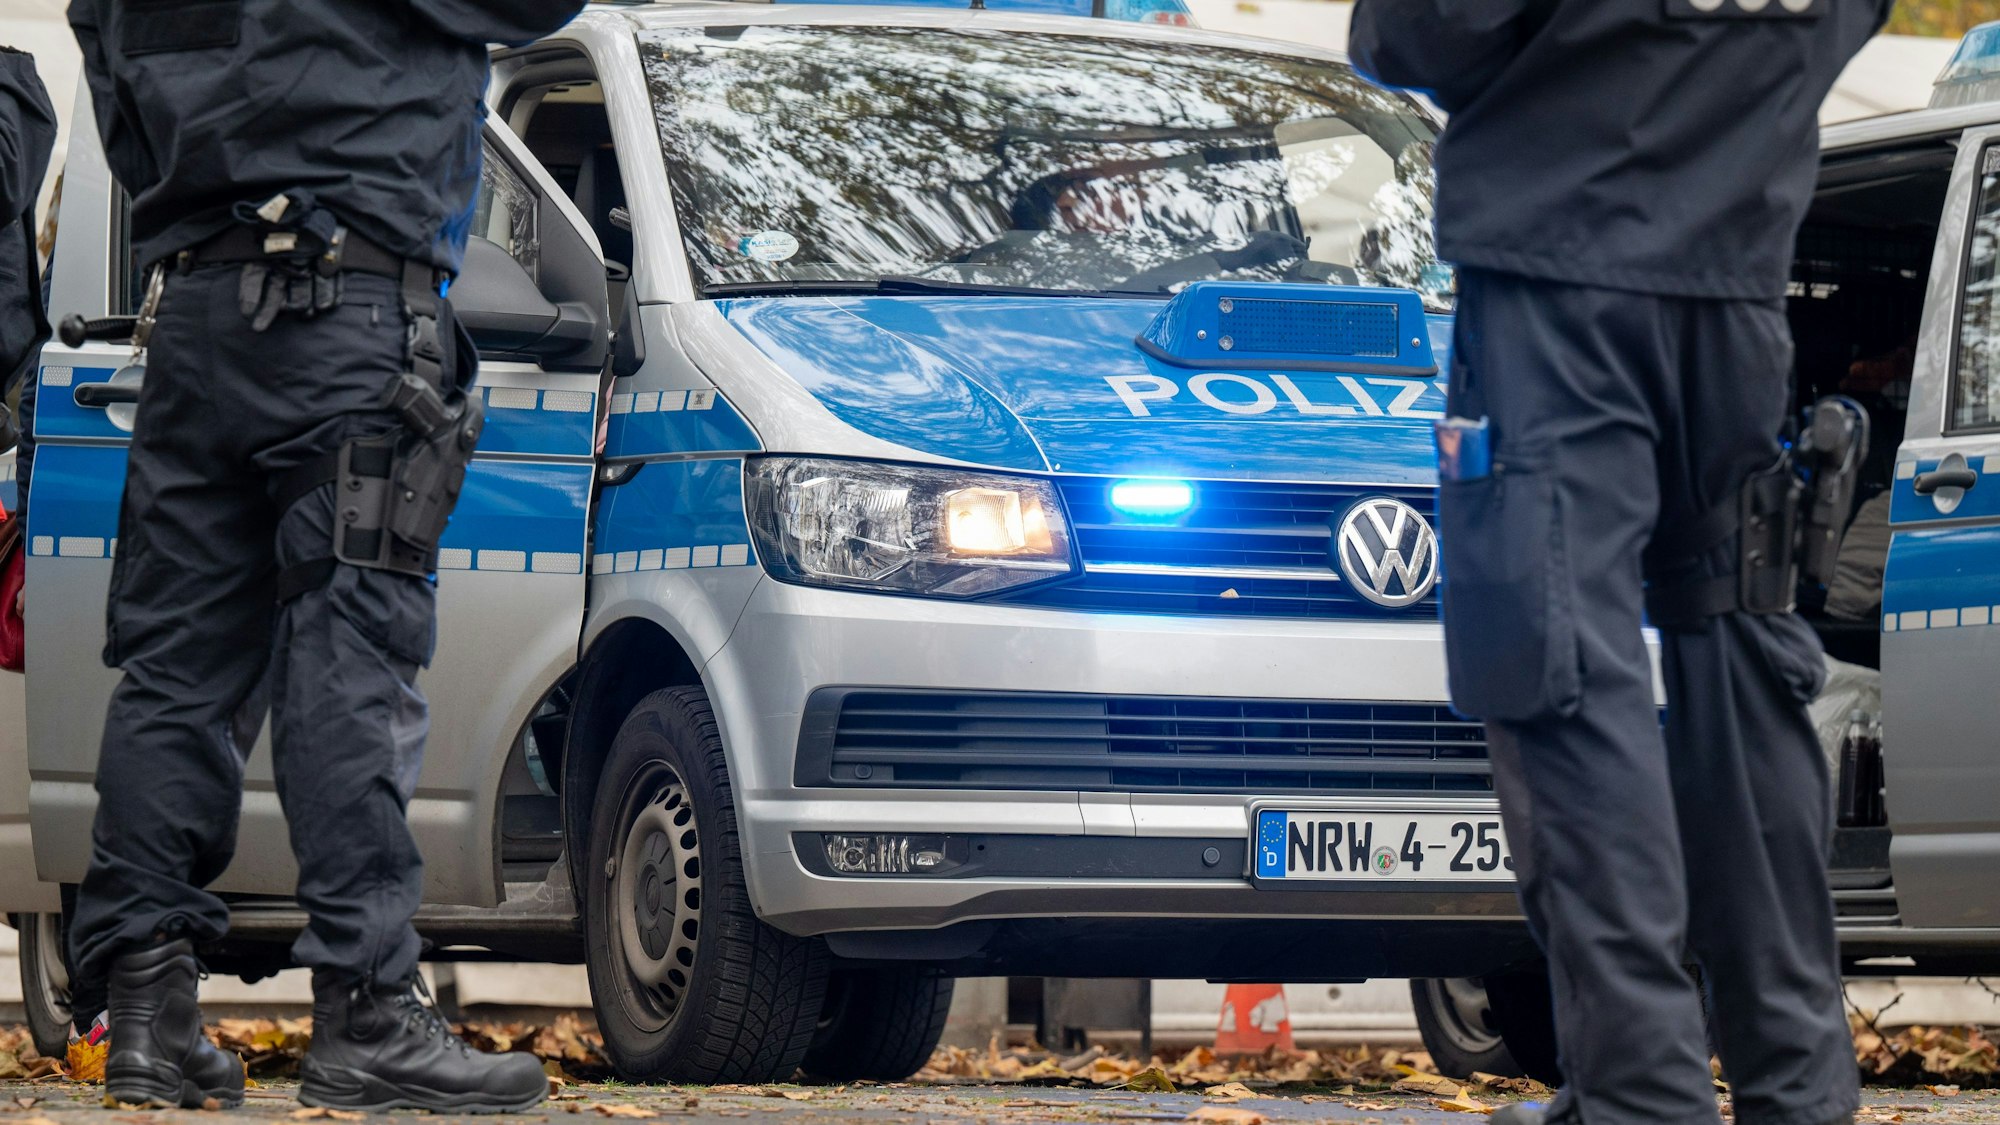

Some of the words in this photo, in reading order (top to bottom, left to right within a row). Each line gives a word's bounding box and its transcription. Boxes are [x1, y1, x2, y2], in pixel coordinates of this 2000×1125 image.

[1103, 373, 1447, 420] POLIZ
[1340, 501, 1437, 603] VW
[1266, 851, 1278, 867] D
[1288, 821, 1373, 872] NRW
[1400, 821, 1516, 872] 4-25
